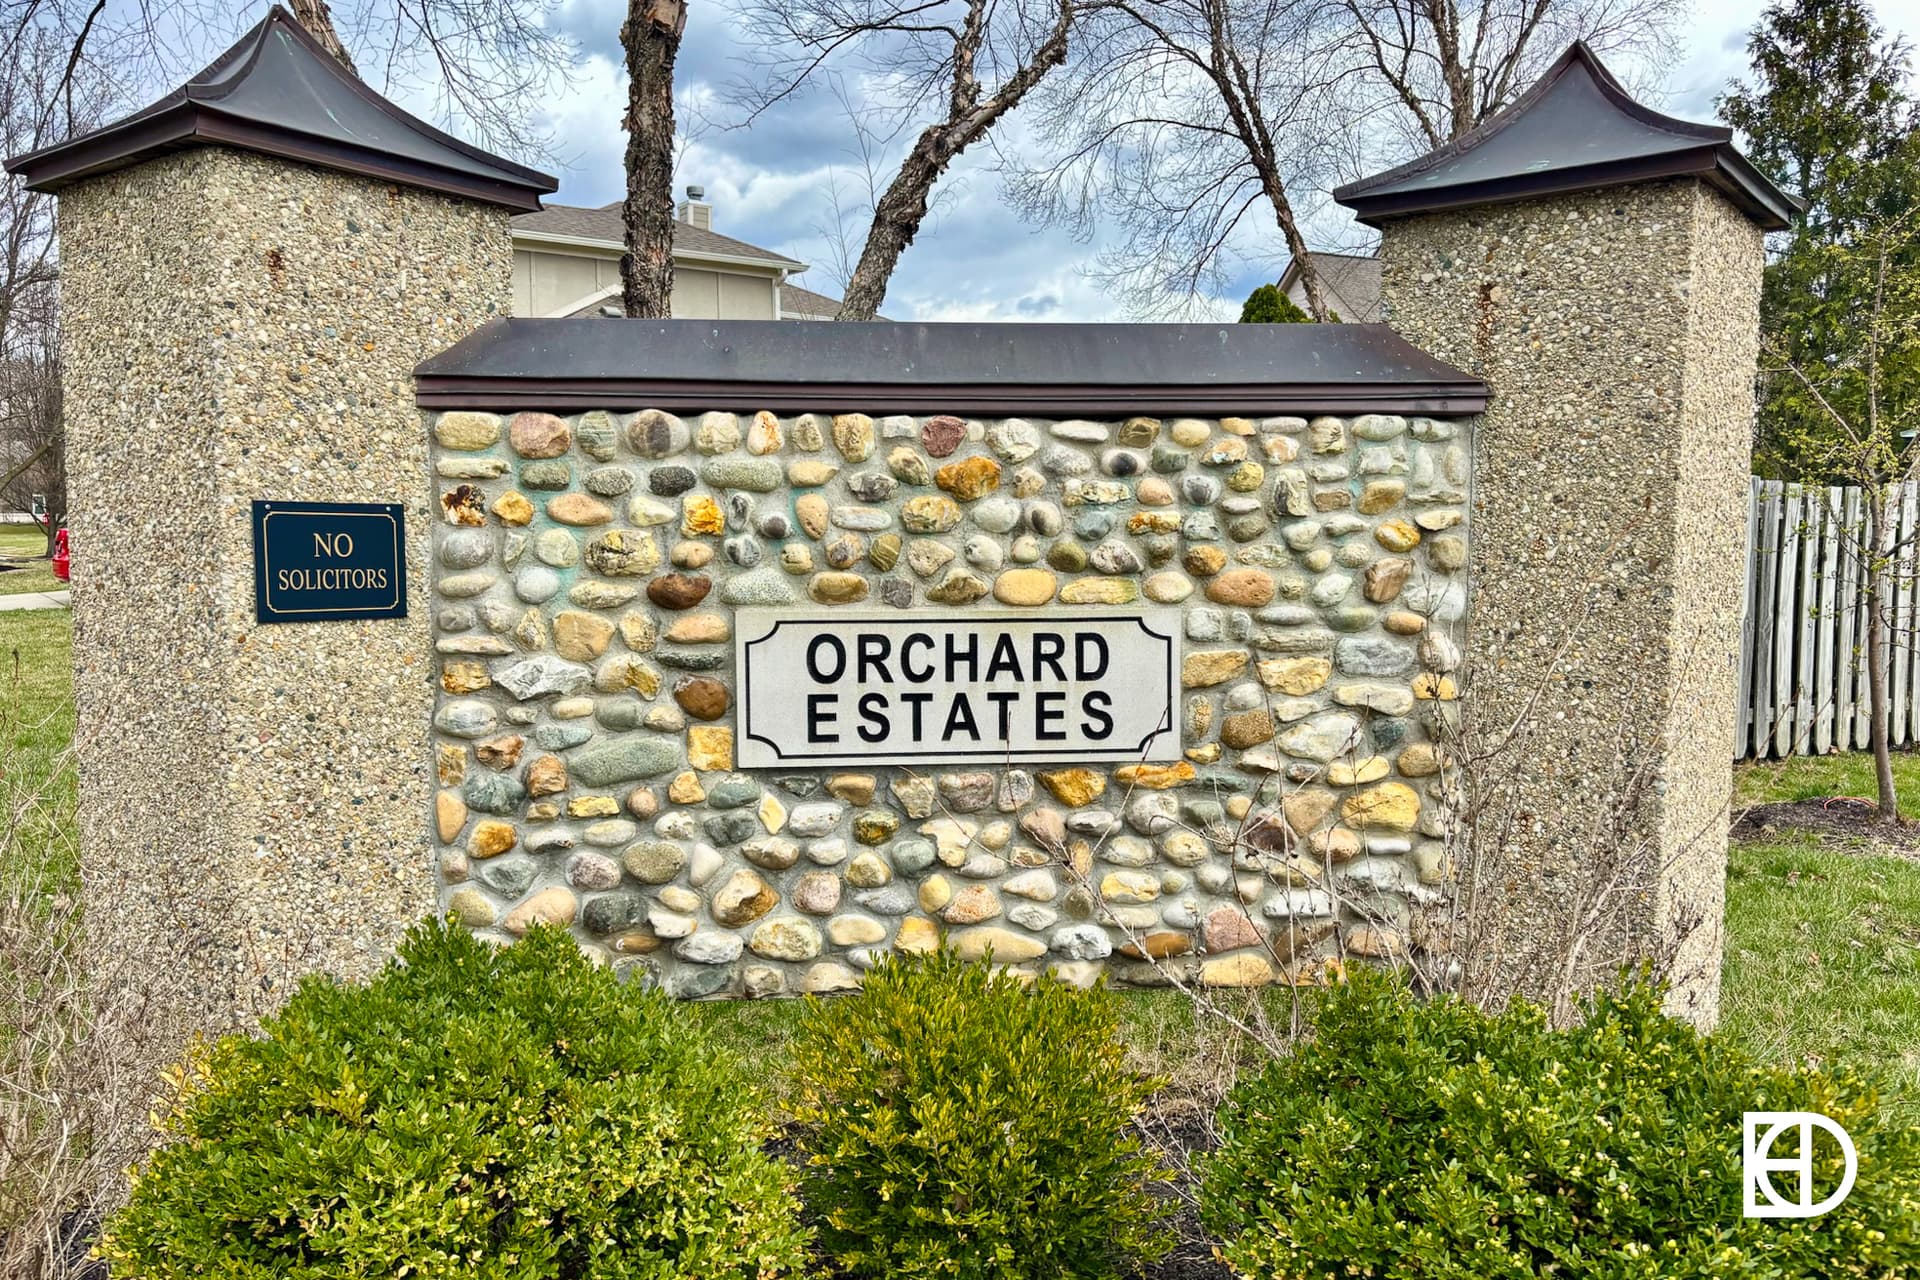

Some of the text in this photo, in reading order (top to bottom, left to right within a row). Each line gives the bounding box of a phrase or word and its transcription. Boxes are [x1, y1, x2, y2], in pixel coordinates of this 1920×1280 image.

[313, 533, 353, 558] NO
[278, 568, 388, 591] SOLICITORS
[806, 631, 1109, 684] ORCHARD
[807, 690, 1114, 743] ESTATES
